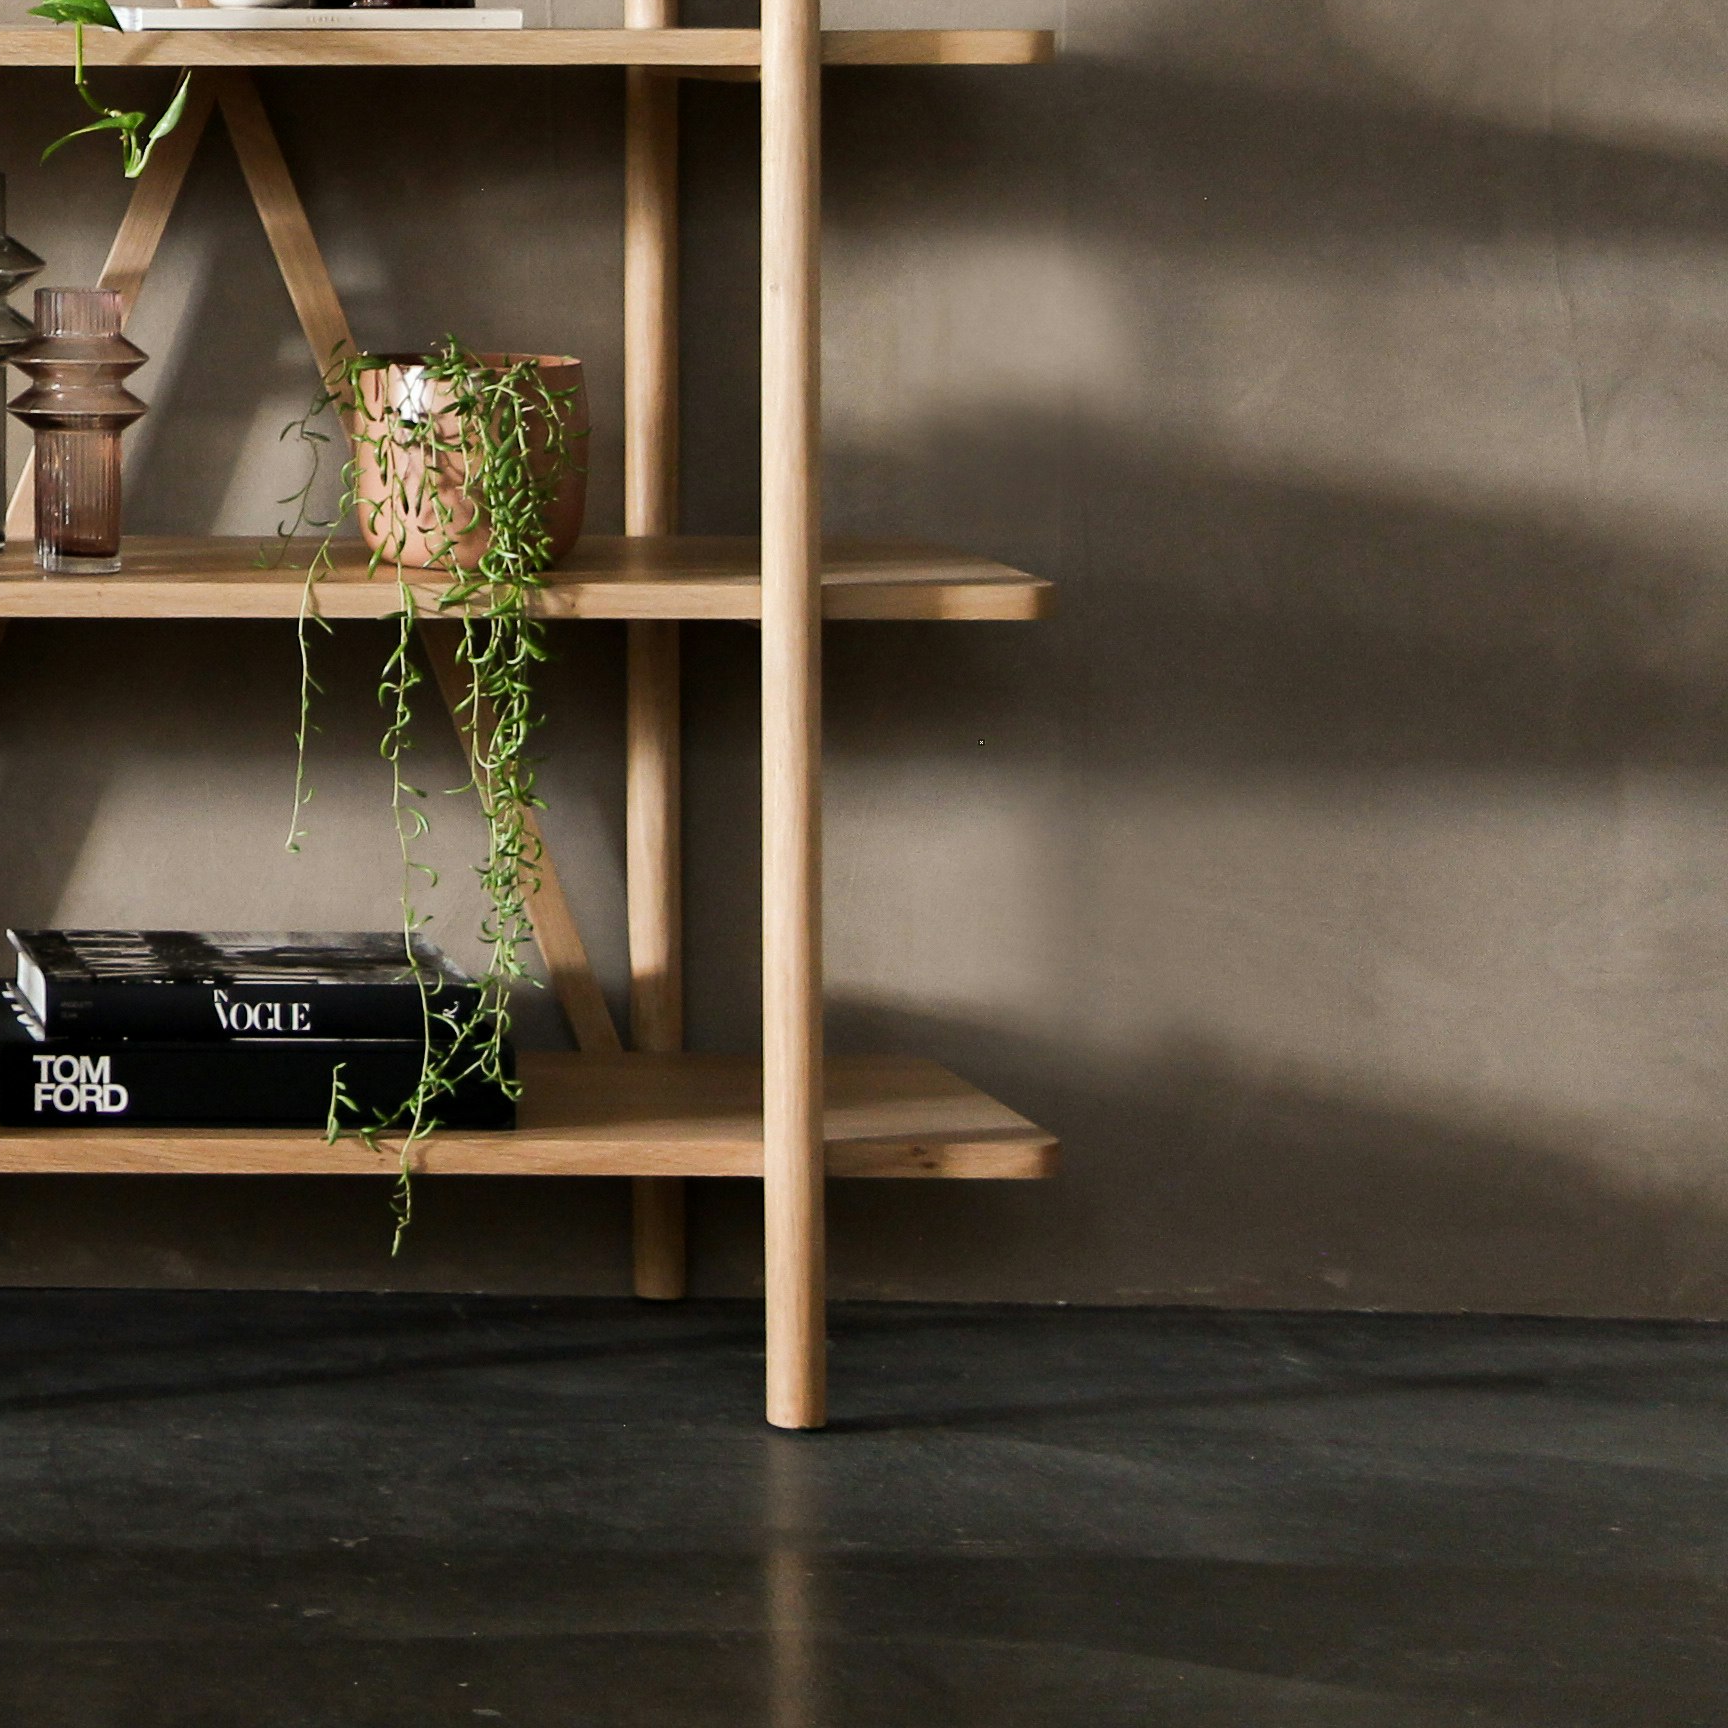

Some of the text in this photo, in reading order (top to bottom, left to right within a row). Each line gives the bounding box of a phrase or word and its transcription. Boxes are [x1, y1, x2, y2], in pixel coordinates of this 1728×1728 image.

[213, 989, 229, 1003] IN
[214, 1002, 311, 1031] VOGUE
[33, 1054, 111, 1084] TOM
[34, 1082, 130, 1113] FORD
